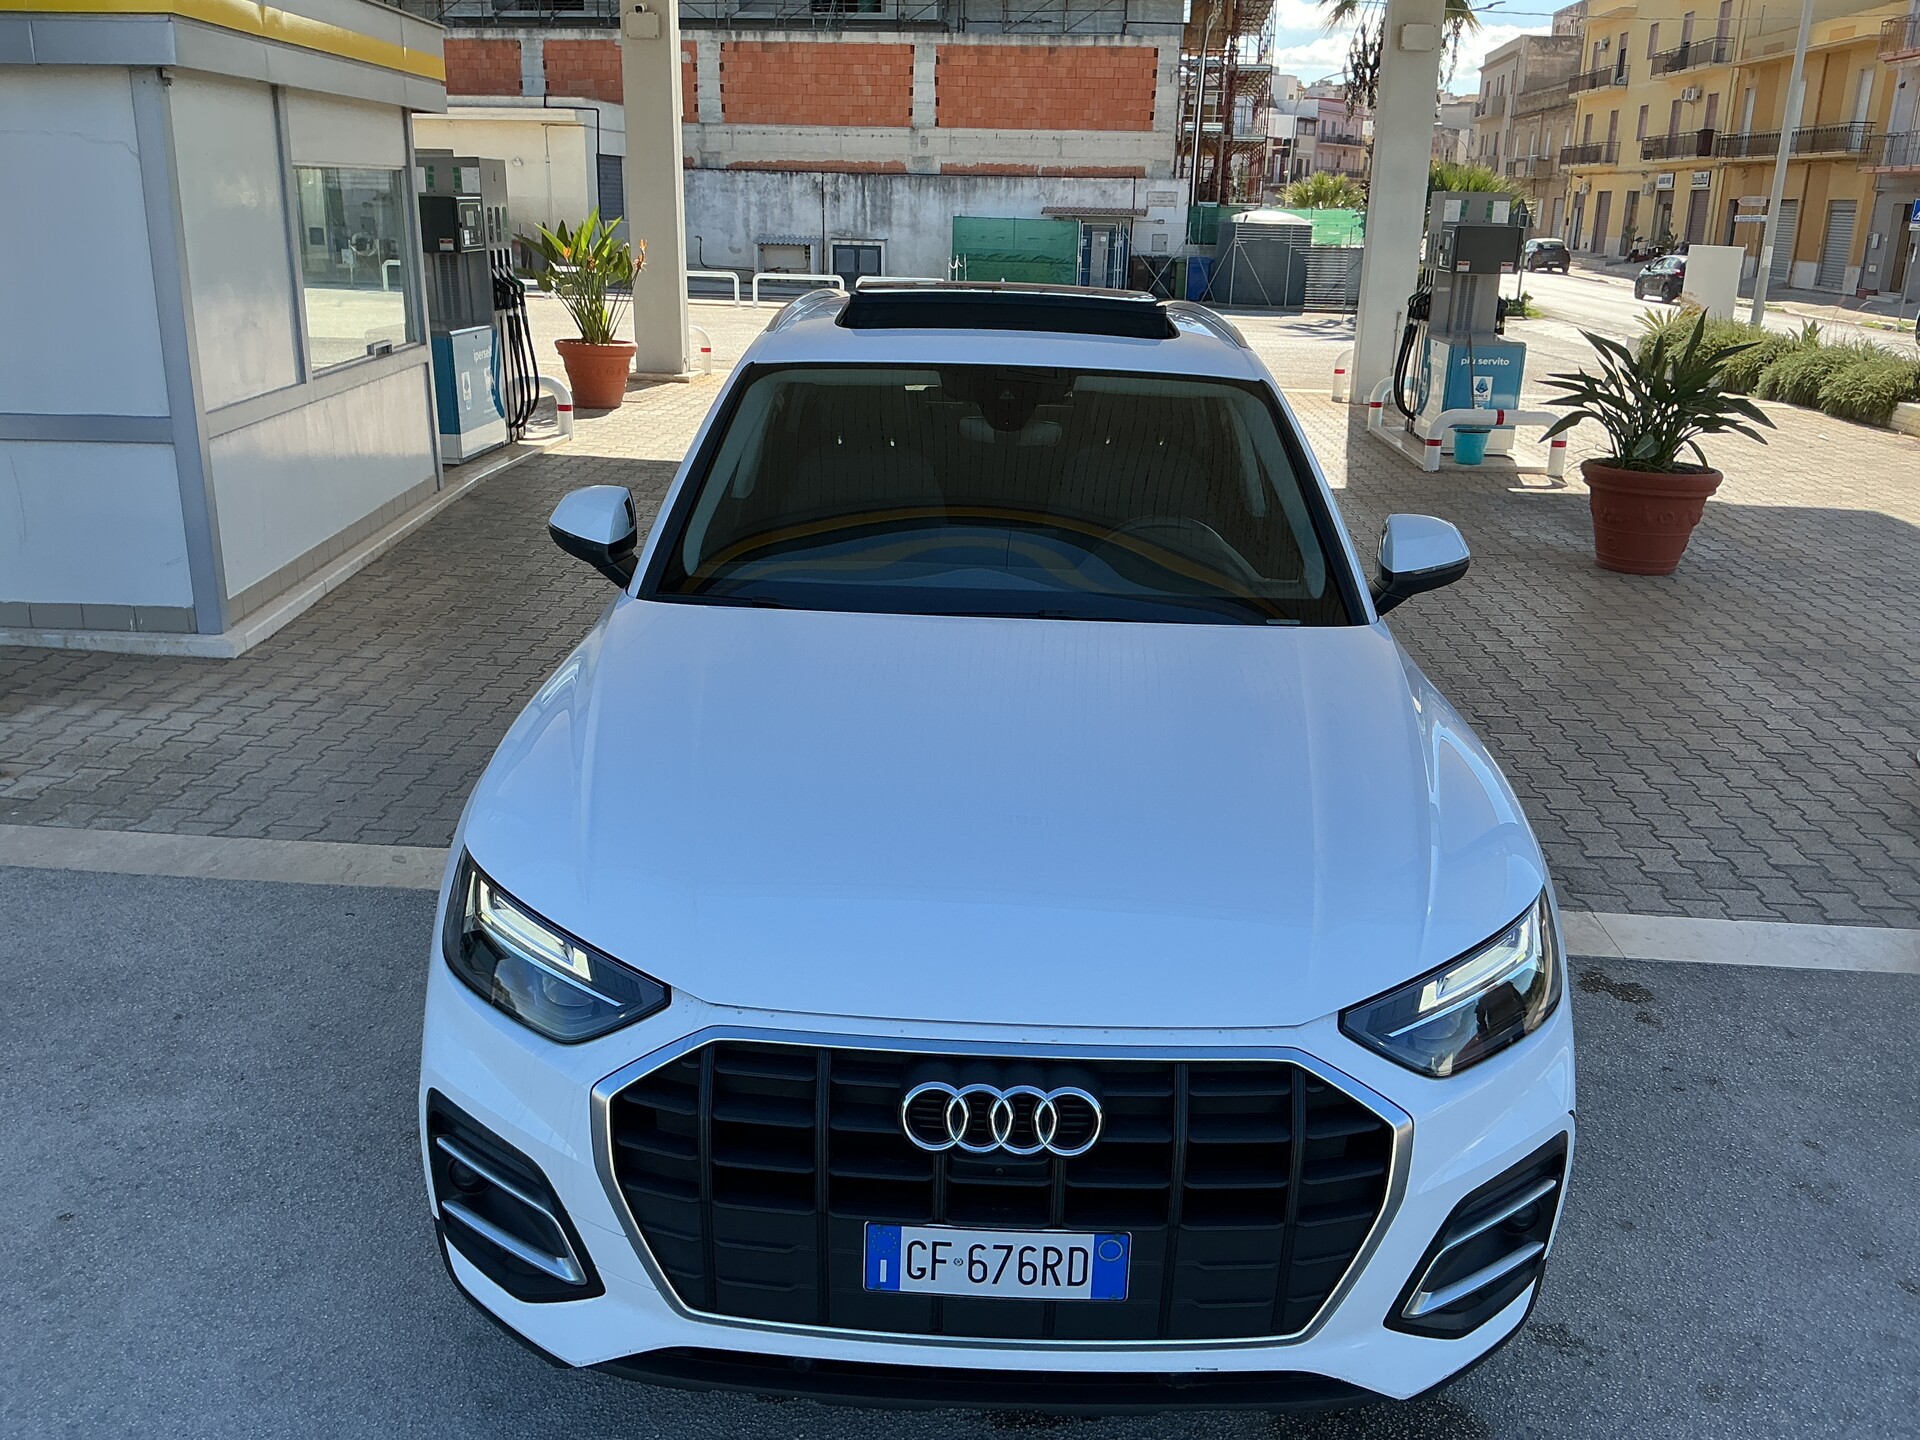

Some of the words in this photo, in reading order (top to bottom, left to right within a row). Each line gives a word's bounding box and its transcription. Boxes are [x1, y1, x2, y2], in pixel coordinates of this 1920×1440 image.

[1477, 357, 1510, 366] servito
[906, 1240, 953, 1281] GF
[967, 1243, 1090, 1287] 676RD
